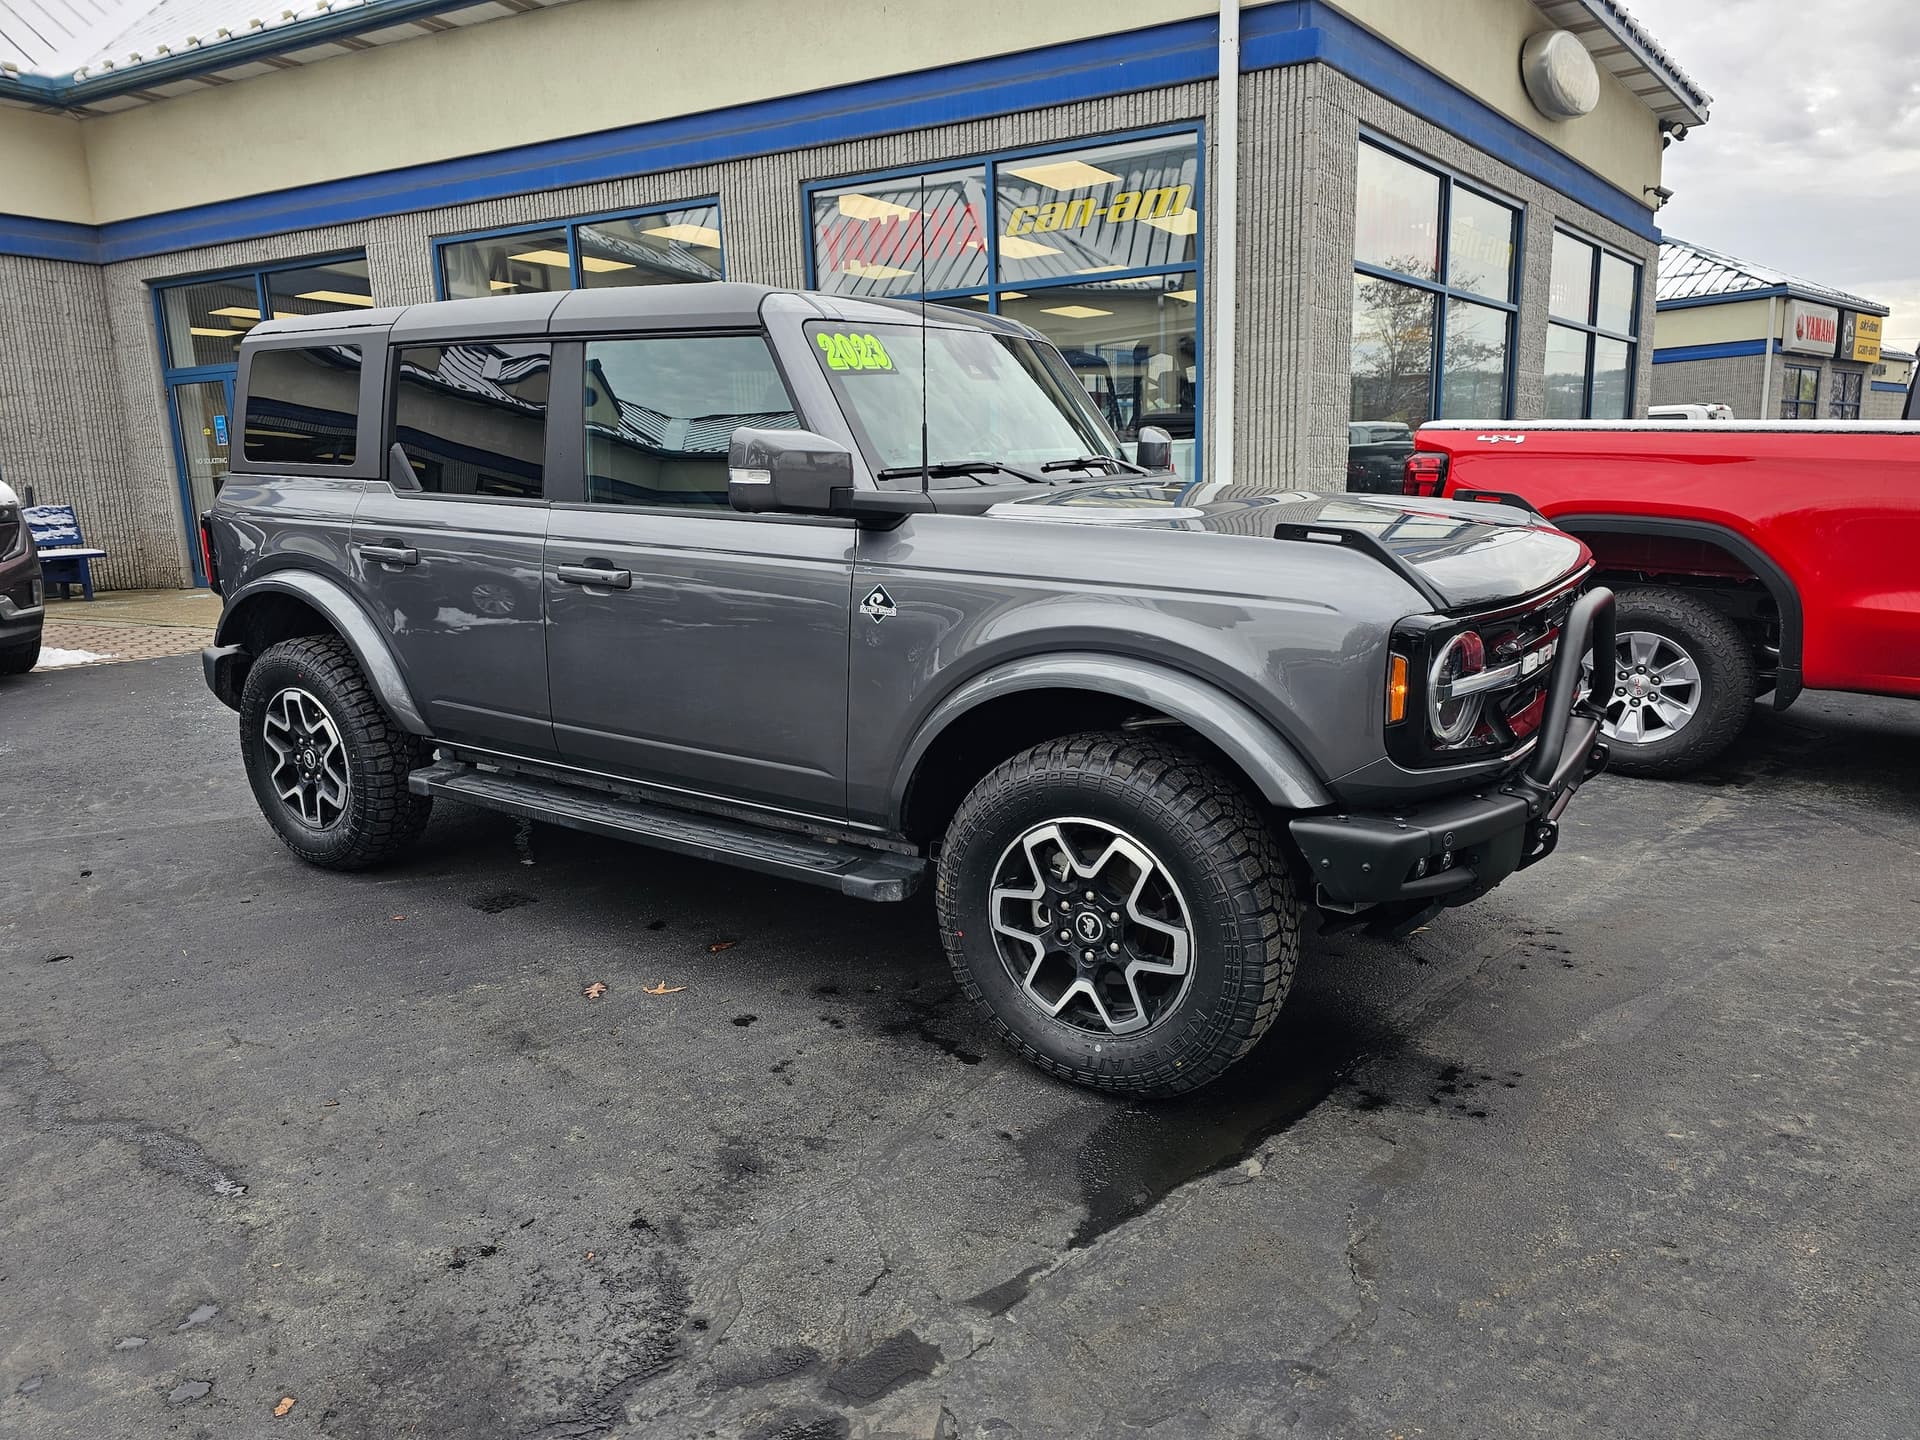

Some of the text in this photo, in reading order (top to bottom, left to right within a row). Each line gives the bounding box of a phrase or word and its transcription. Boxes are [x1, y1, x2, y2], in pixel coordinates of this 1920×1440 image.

[1005, 183, 1192, 238] can-am
[821, 202, 988, 272] YAMAHA
[817, 333, 893, 370] 2023
[1806, 315, 1835, 344] YAMAHA
